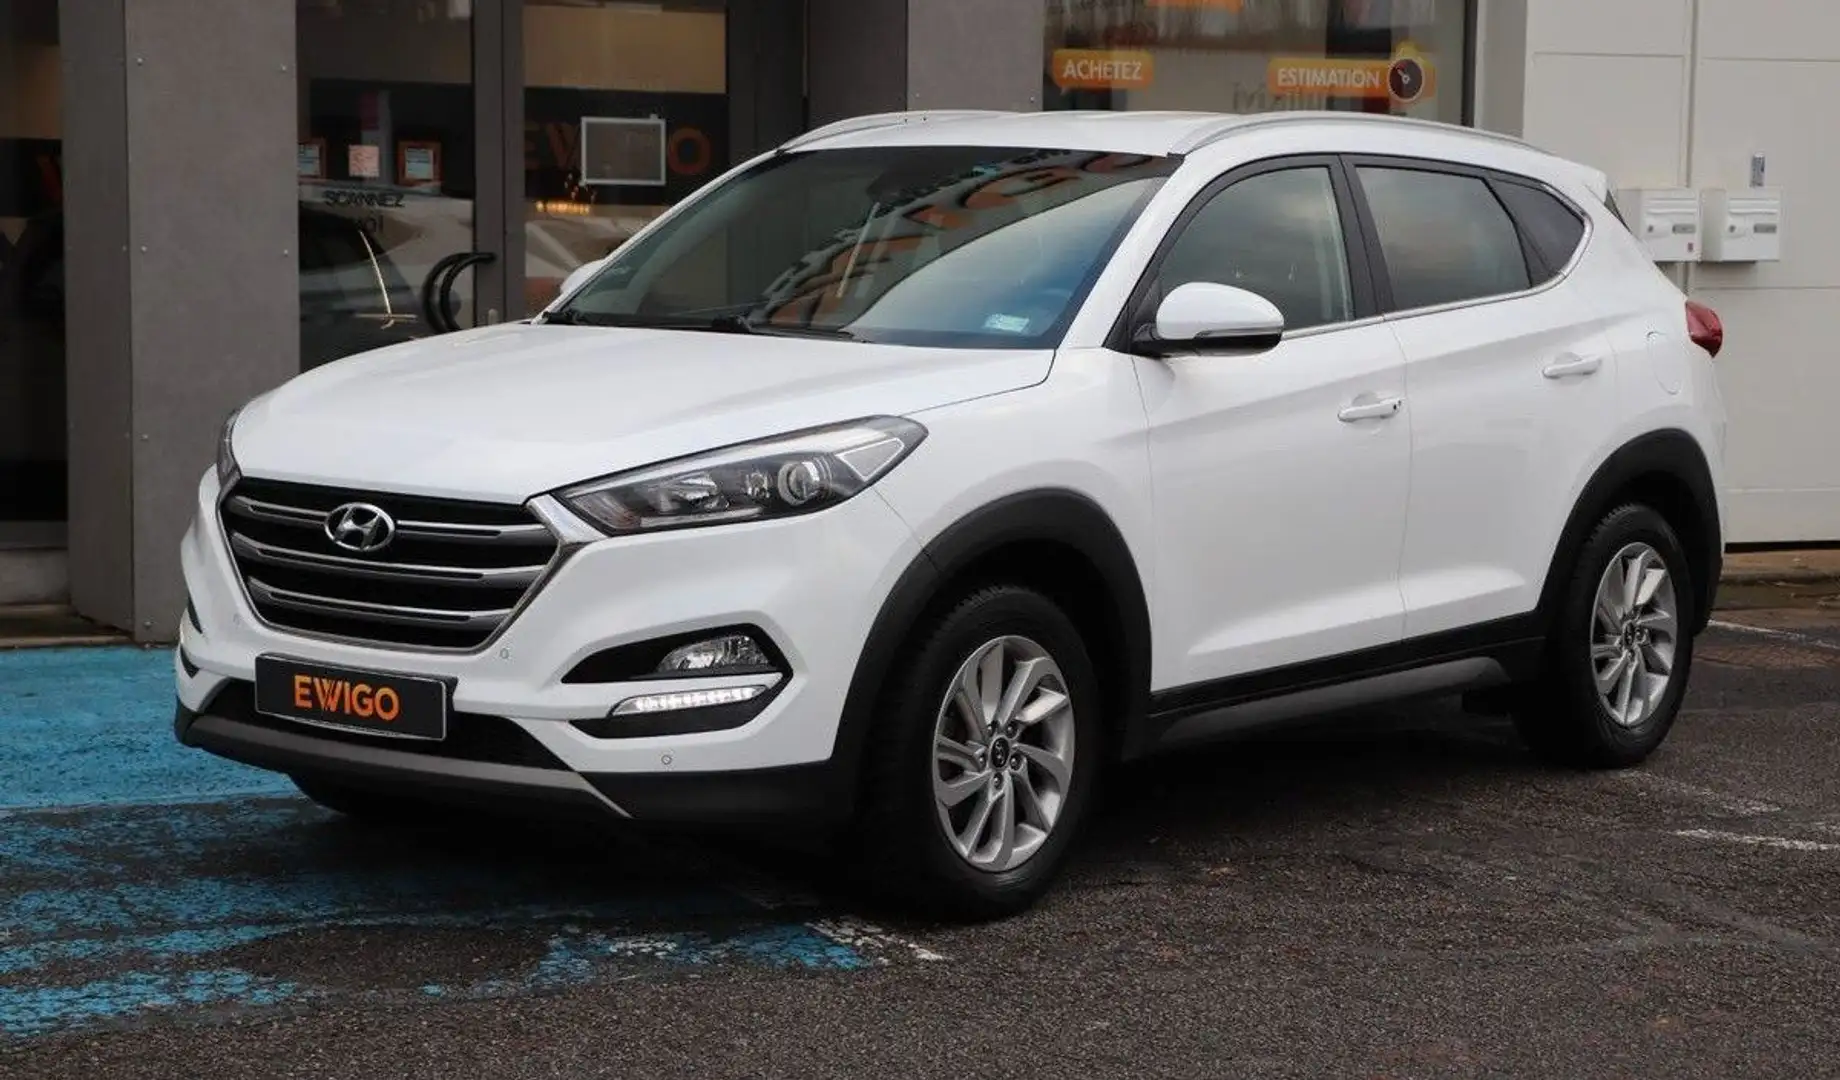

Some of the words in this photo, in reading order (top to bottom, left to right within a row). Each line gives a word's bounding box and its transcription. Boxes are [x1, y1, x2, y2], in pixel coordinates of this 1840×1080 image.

[1063, 58, 1143, 81] ACHETEZ
[1277, 67, 1382, 90] ESTIMATION
[294, 674, 400, 721] EWIGO
